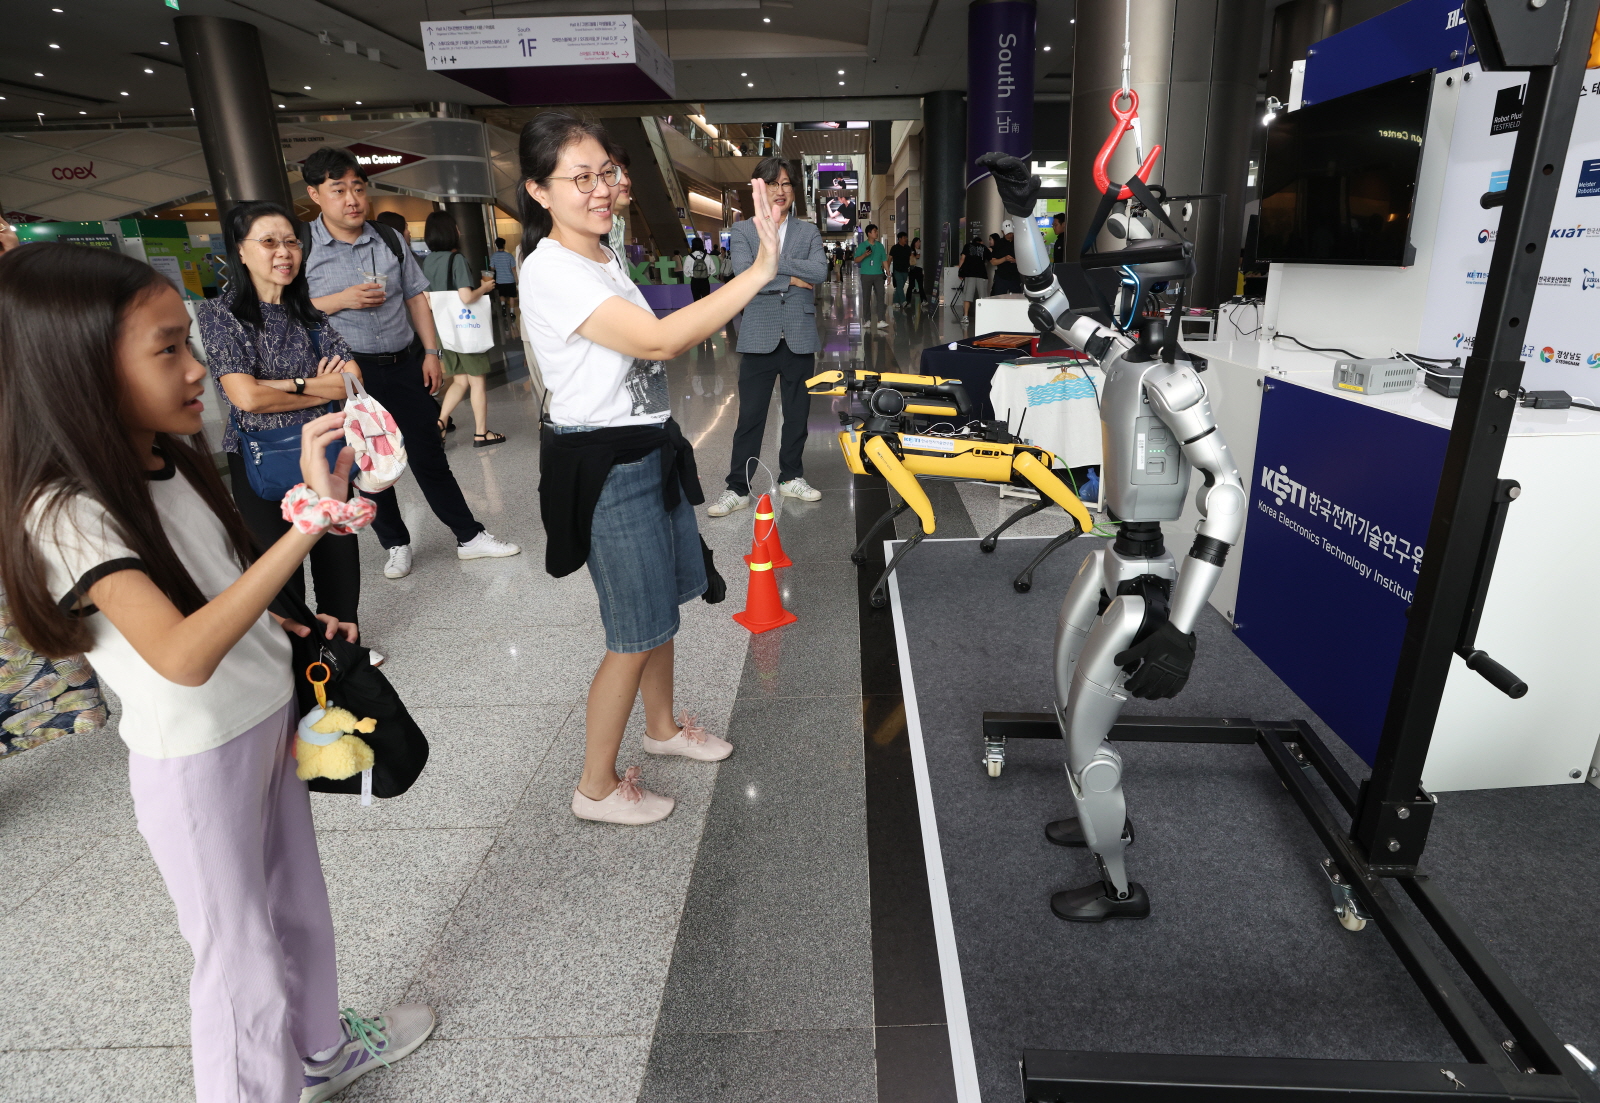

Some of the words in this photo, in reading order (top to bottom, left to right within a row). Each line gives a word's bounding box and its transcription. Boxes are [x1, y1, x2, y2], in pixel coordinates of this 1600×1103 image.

[518, 38, 537, 57] 1F
[998, 33, 1017, 98] South
[997, 116, 1011, 134] 남
[1494, 115, 1510, 123] Robot
[1510, 112, 1522, 120] Plus
[1493, 120, 1520, 131] TESTFIELD
[371, 154, 403, 165] Center
[1555, 359, 1580, 367] GYEONGNAM
[1557, 350, 1582, 362] 경상남도
[1261, 465, 1308, 509] KETI
[1309, 491, 1424, 575] 한국전자기술연구원
[1258, 499, 1277, 519] Korea
[1278, 511, 1320, 546] Electronics
[1321, 537, 1372, 579] Technology
